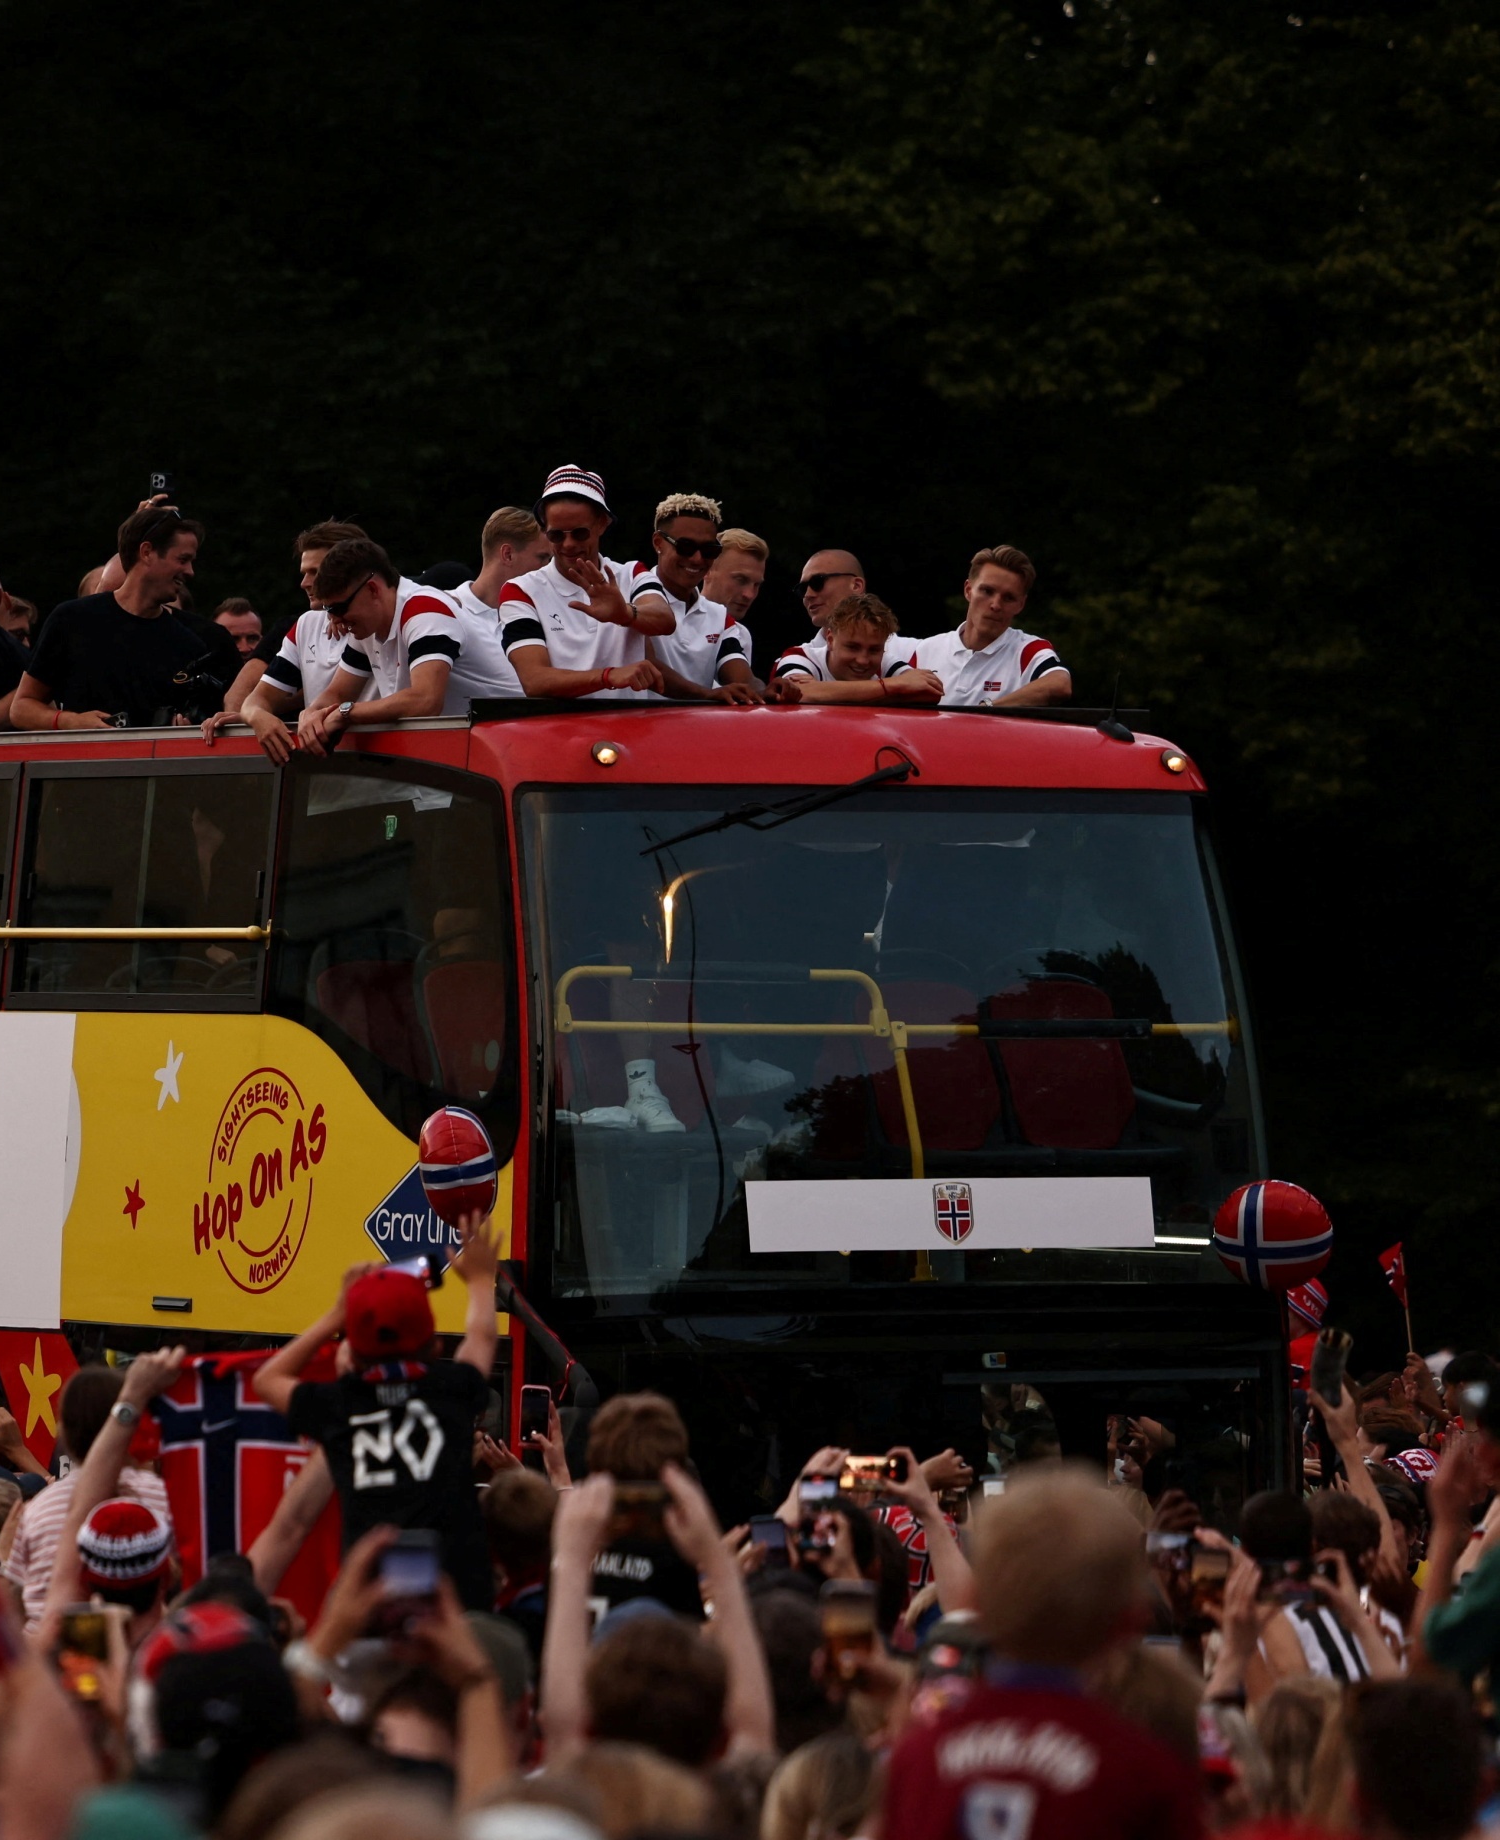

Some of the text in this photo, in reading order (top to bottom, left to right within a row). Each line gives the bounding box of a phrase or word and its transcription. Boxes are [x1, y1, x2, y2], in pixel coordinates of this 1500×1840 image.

[217, 1081, 289, 1162] SIGHTSEEING
[289, 1103, 327, 1182] AS
[249, 1235, 292, 1283] NORWAY
[375, 1208, 425, 1242] Gray
[348, 1398, 445, 1490] 20
